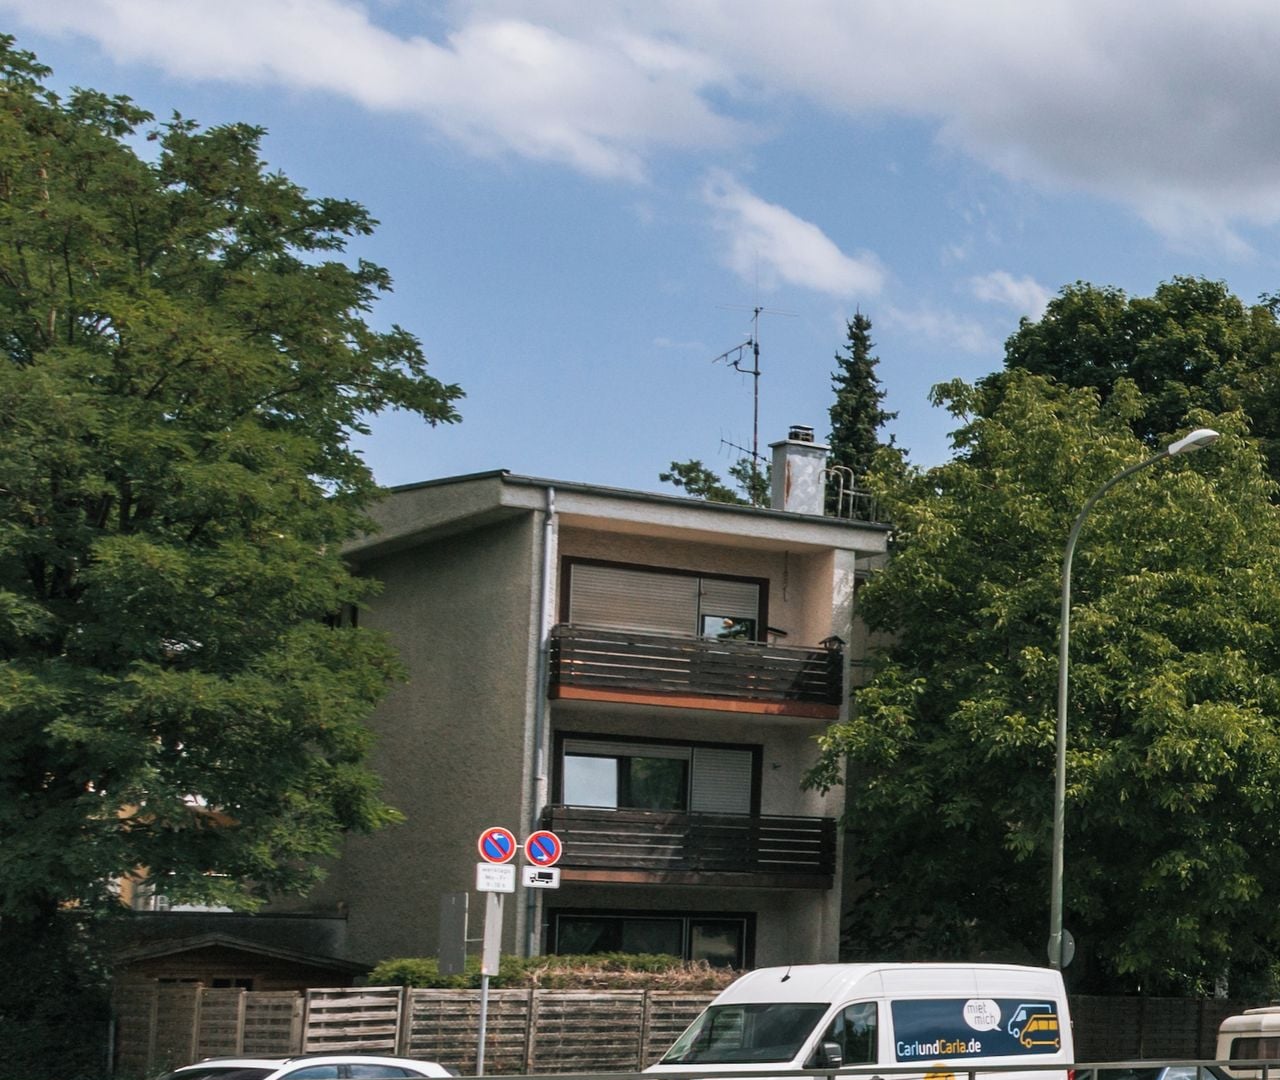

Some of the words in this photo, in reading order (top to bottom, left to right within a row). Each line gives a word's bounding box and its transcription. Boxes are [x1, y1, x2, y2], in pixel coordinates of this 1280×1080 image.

[967, 1003, 987, 1014] miet
[974, 1014, 996, 1025] mich
[896, 1038, 982, 1056] CarlundCarla.de
